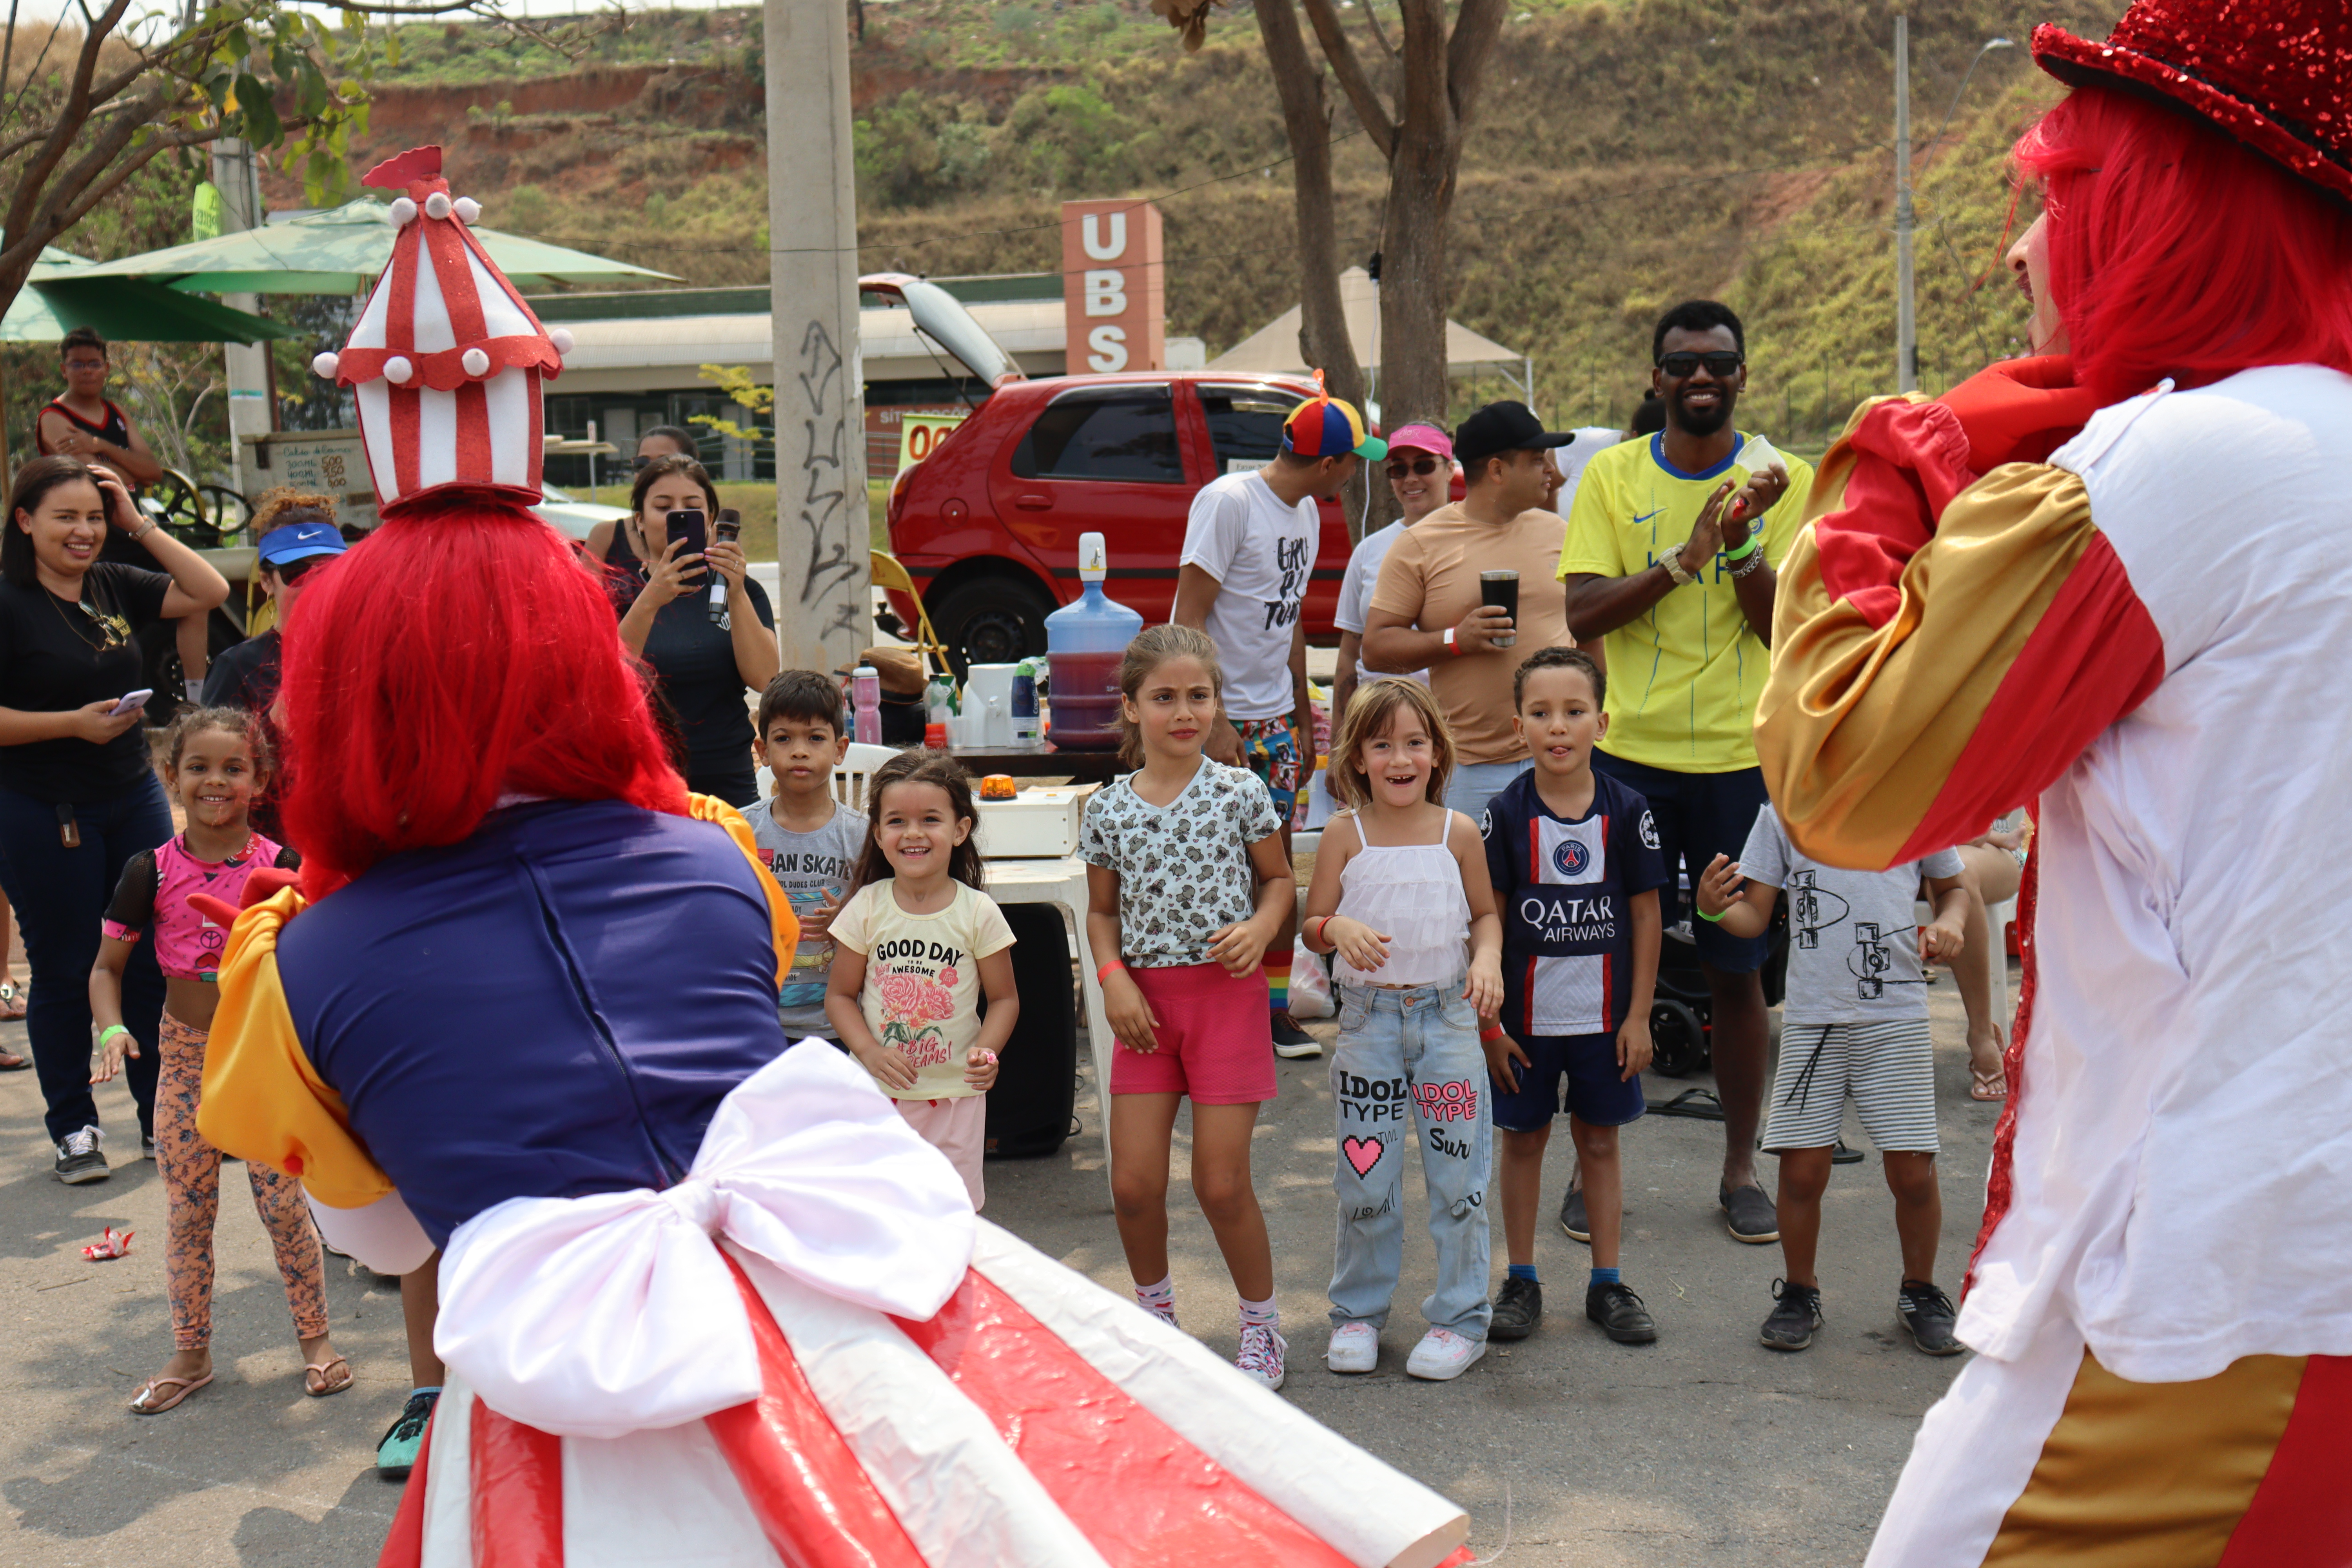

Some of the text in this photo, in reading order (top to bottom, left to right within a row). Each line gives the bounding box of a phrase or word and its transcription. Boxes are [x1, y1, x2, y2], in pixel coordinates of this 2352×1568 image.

[1082, 212, 1129, 373] UBS
[1561, 844, 1582, 852] PARIS
[809, 879, 825, 887] CLUB
[1521, 896, 1614, 930] QATAR
[1544, 922, 1615, 942] AIRWAYS
[877, 939, 964, 968] GOOD DAY
[892, 965, 935, 977] AWESOME
[1340, 1071, 1407, 1102] IDOL
[1412, 1079, 1477, 1102] IDOL
[1340, 1099, 1405, 1122] TYPE
[1416, 1098, 1477, 1122] TYPE
